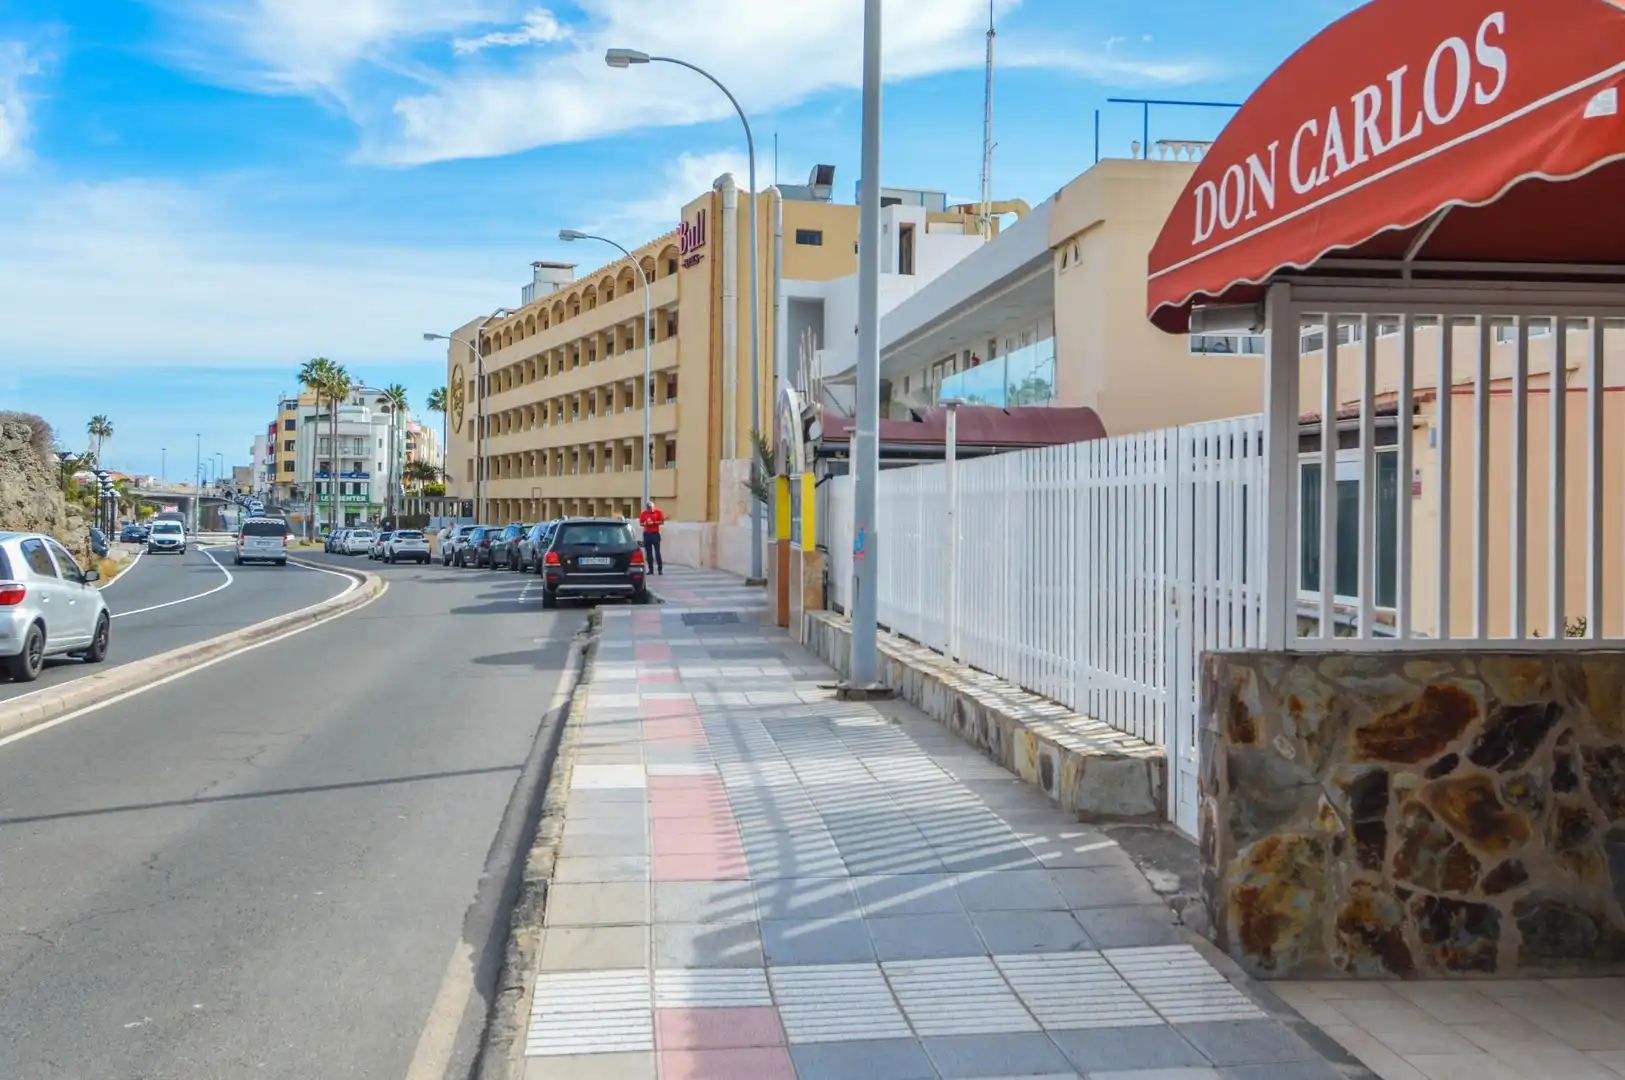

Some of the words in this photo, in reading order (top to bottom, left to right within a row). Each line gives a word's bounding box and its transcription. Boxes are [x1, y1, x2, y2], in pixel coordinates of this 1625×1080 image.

[1191, 140, 1279, 246] DON
[1288, 11, 1508, 195] CARLOS
[676, 208, 706, 256] Bull
